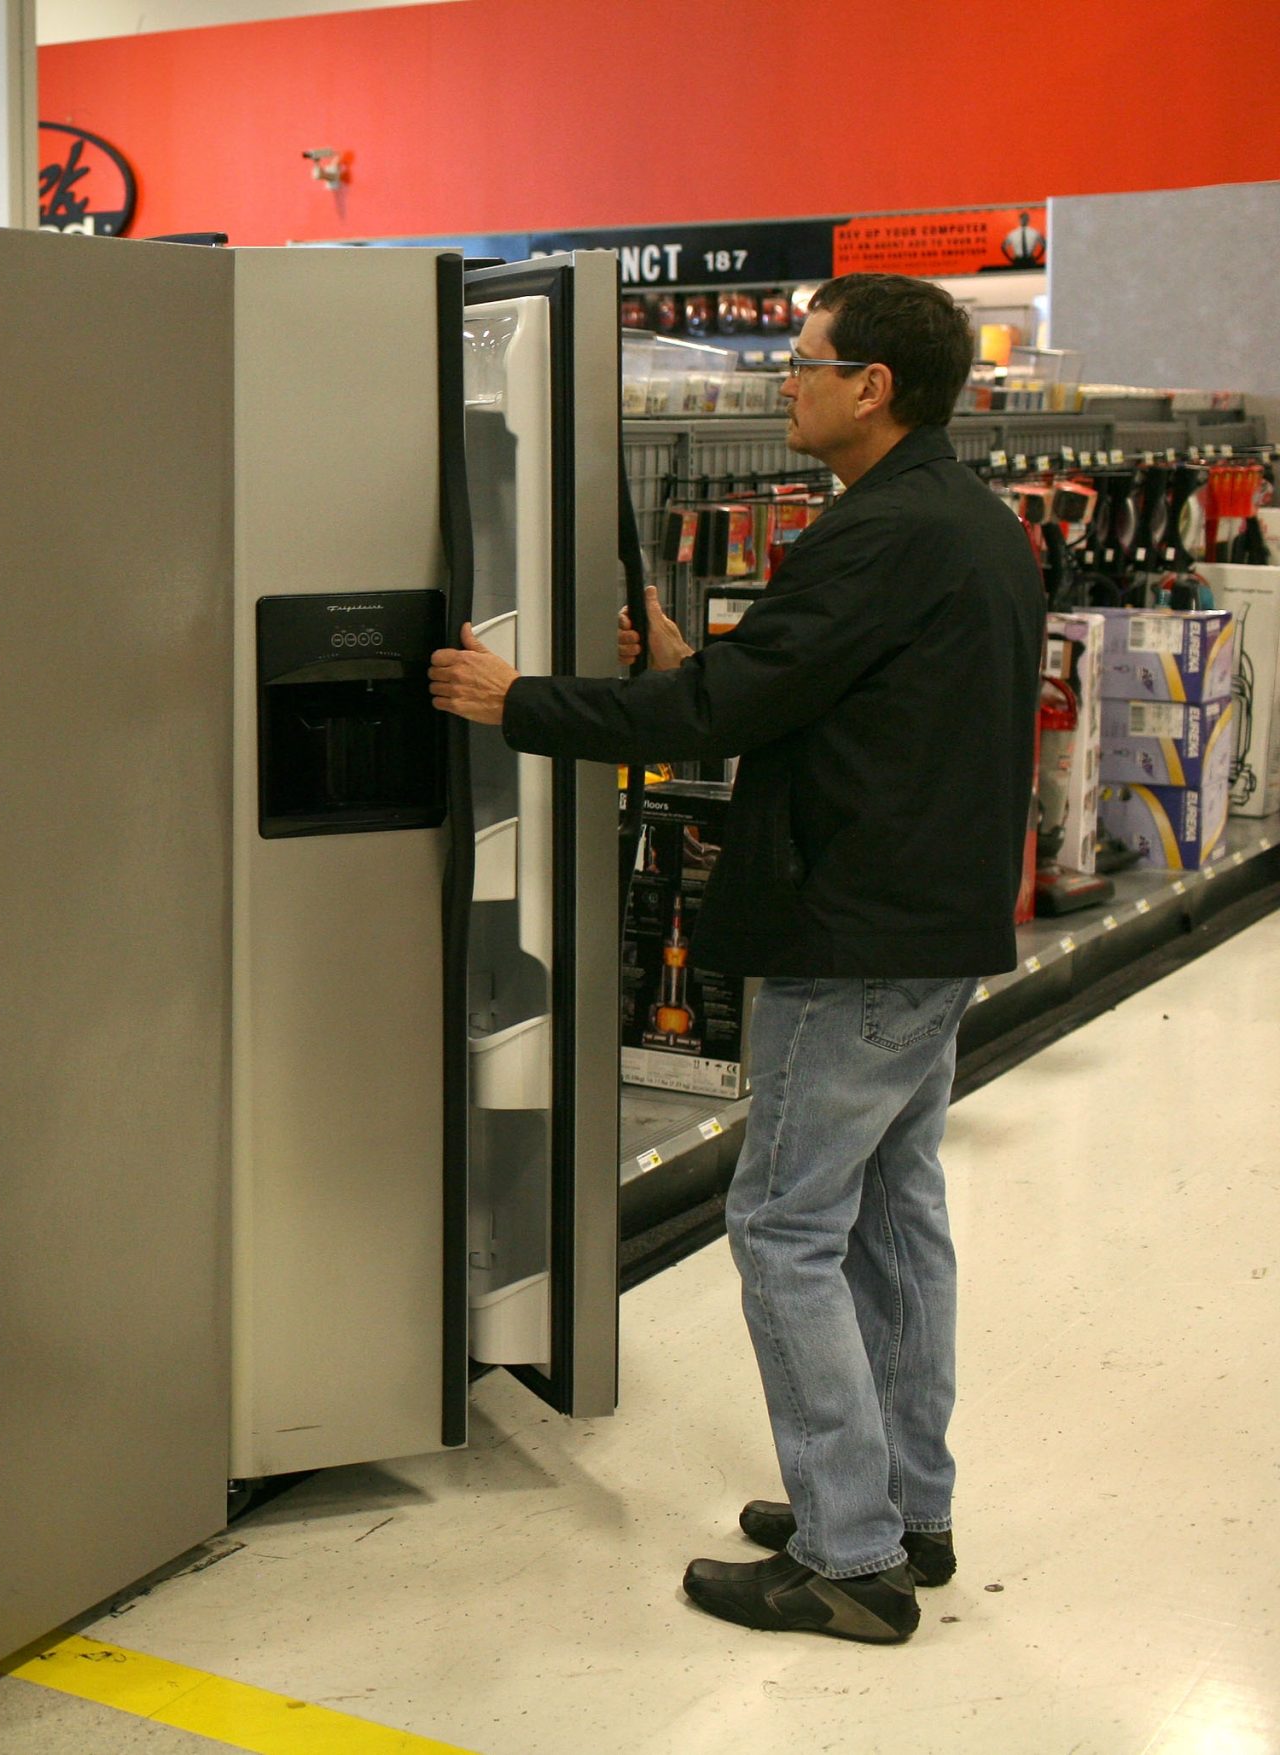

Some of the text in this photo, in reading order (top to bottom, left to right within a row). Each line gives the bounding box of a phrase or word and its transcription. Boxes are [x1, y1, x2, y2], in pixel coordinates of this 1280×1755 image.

[885, 226, 916, 237] YOUR
[922, 223, 986, 235] COMPUTER
[704, 250, 748, 272] 187
[1188, 620, 1201, 673] EUREKA
[1187, 706, 1200, 759] EUREKA
[1185, 790, 1198, 842] EUREKA
